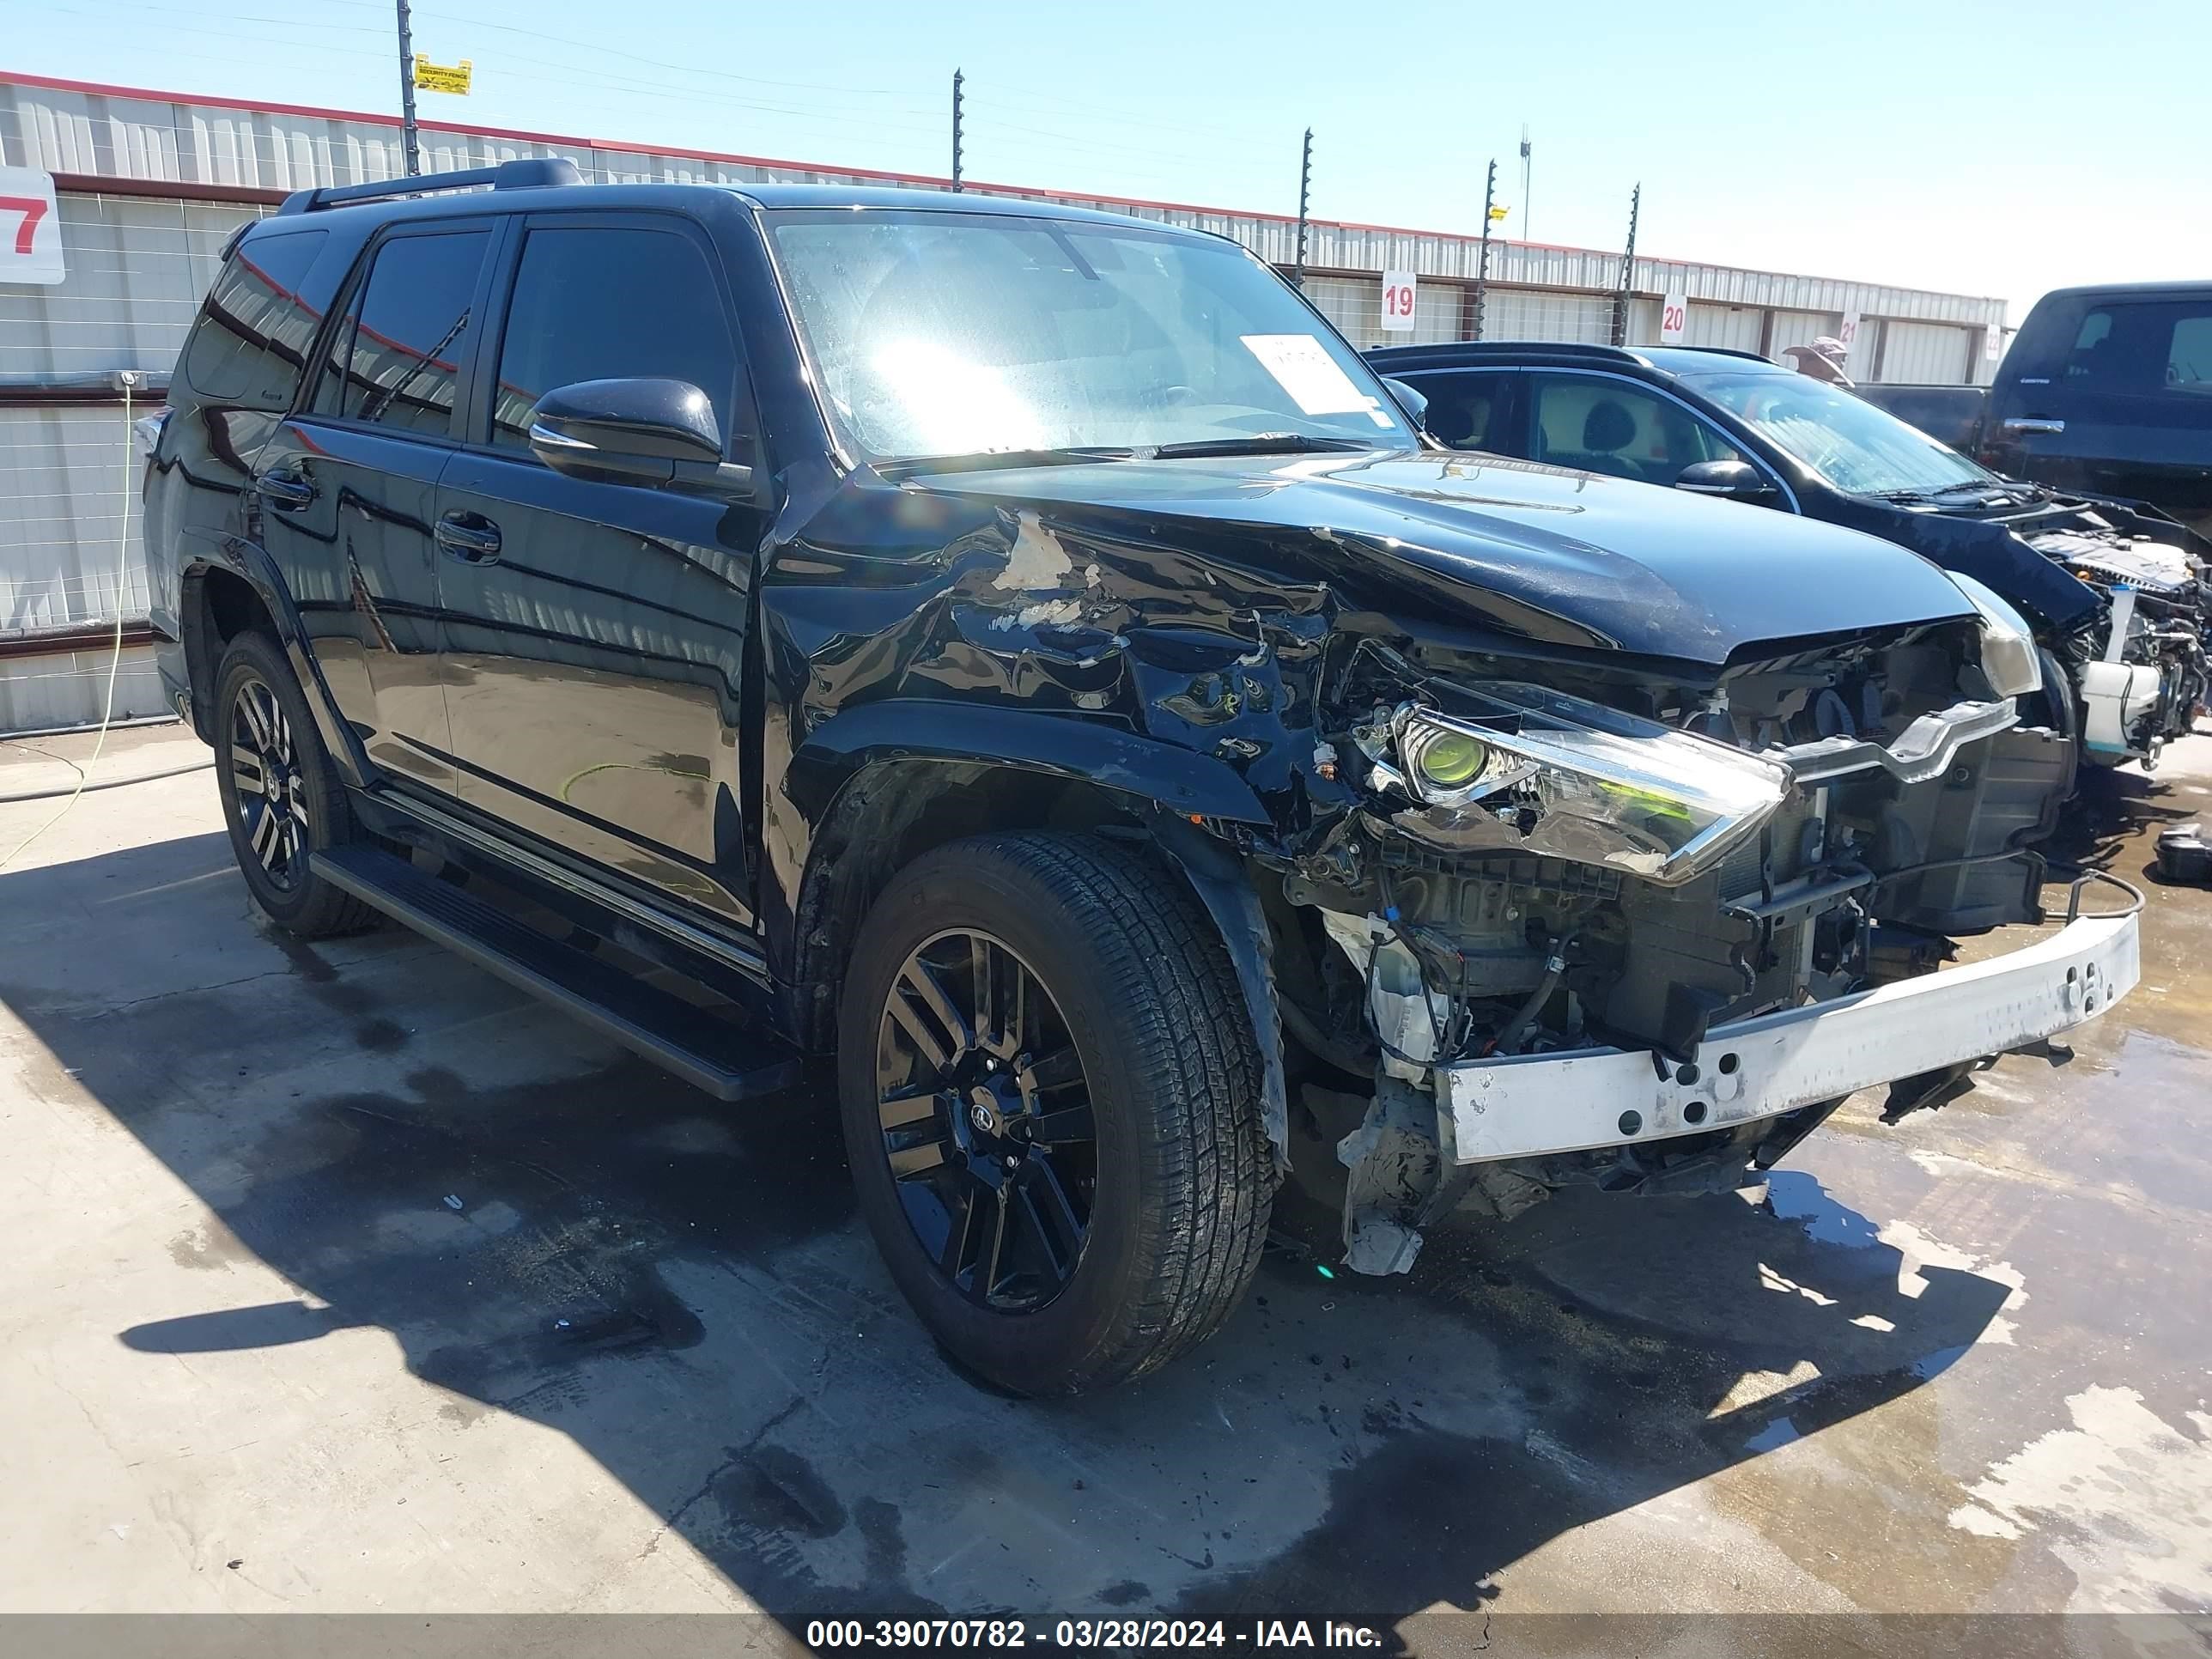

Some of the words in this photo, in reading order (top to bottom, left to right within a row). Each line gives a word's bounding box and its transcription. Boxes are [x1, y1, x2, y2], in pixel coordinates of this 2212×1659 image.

[418, 68, 447, 76] SECURITY
[1385, 284, 1413, 316] 19
[1663, 306, 1683, 331] 20
[1840, 322, 1856, 343] 21
